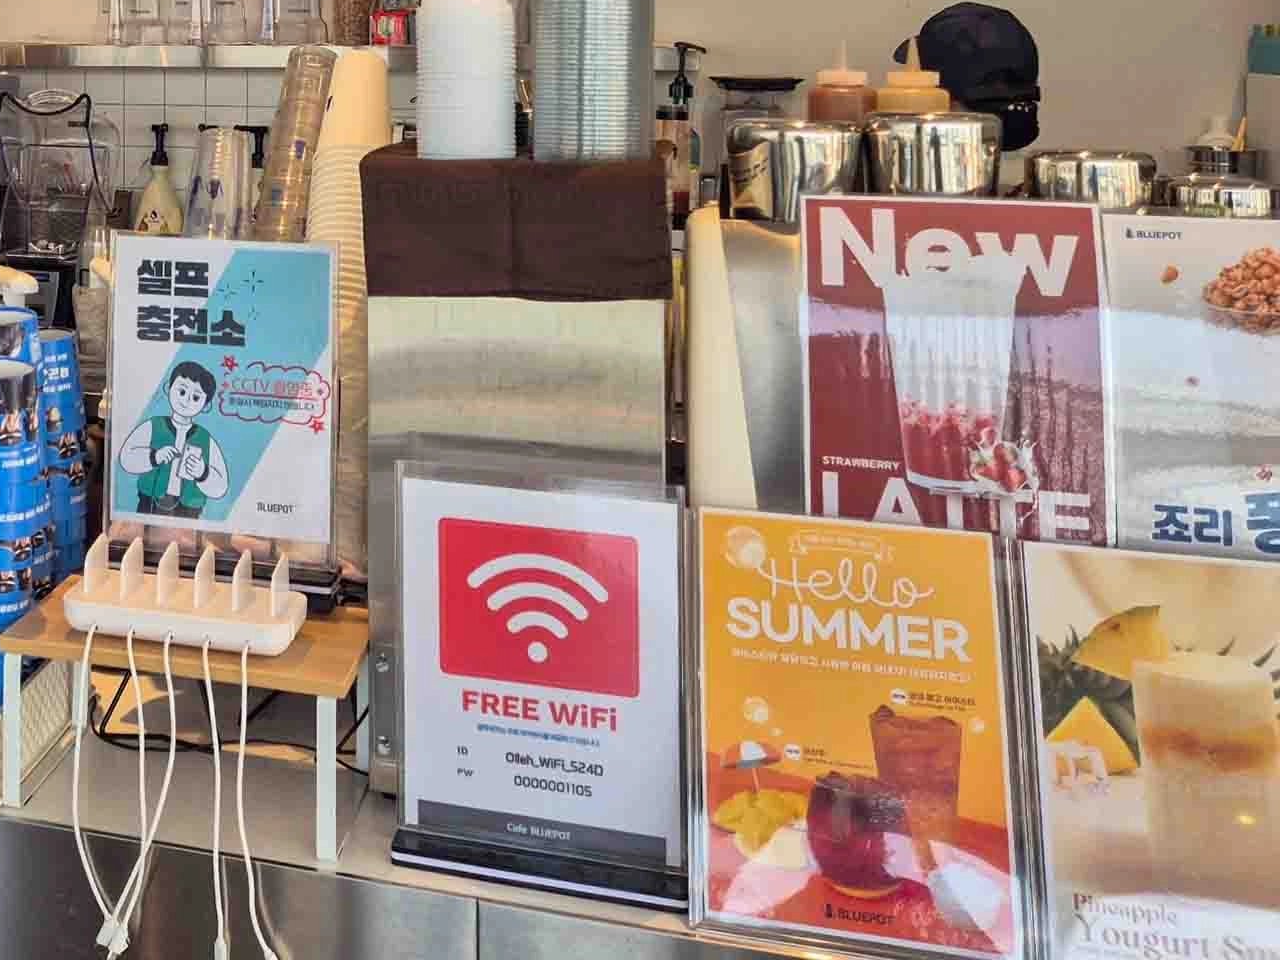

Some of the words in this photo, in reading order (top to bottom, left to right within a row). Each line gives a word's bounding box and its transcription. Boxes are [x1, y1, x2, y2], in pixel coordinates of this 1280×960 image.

[819, 206, 1080, 297] New
[1136, 229, 1183, 240] BLUEPOT
[137, 259, 210, 298] 셀프
[137, 304, 246, 347] 충전소
[822, 455, 900, 472] STRAWBERRY
[257, 502, 296, 514] BLUEPOT
[758, 556, 936, 607] Hello
[725, 596, 972, 663] SUMMER
[462, 689, 540, 722] FREE
[548, 700, 617, 732] WiFi
[457, 745, 468, 756] ID
[456, 767, 474, 778] PW
